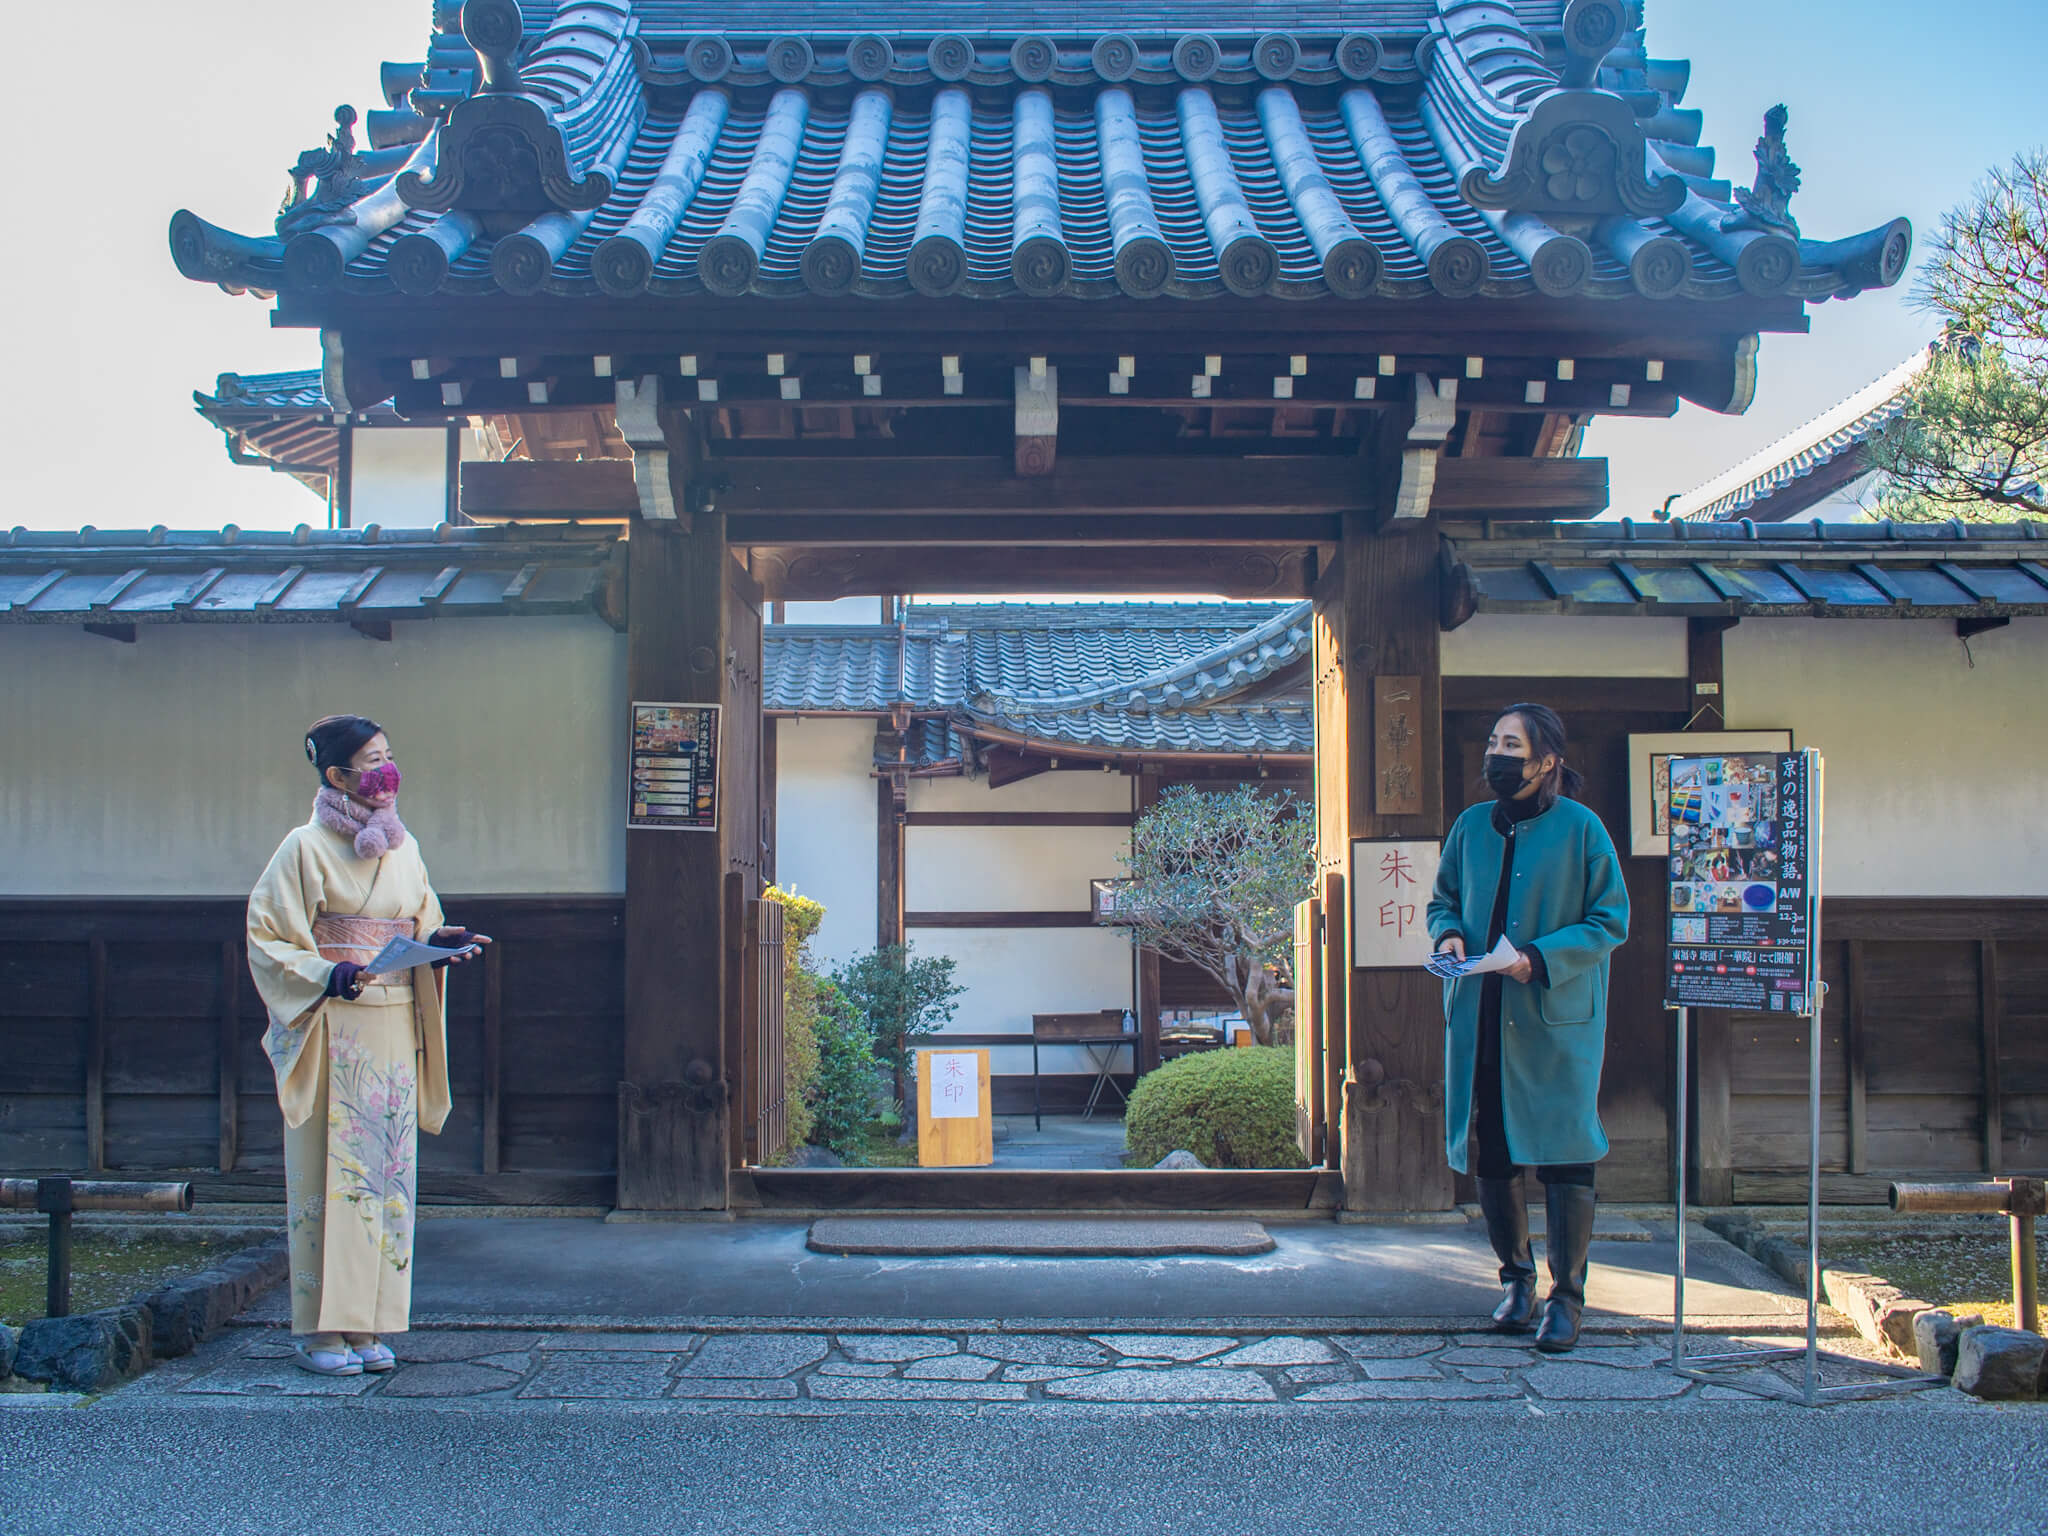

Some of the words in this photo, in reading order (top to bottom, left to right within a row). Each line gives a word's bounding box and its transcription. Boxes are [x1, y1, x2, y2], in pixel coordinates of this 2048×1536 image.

[1782, 757, 1799, 879] 京の逸品物語
[1379, 849, 1416, 938] 朱印
[1779, 888, 1801, 899] A/W
[944, 1058, 964, 1104] 朱印
